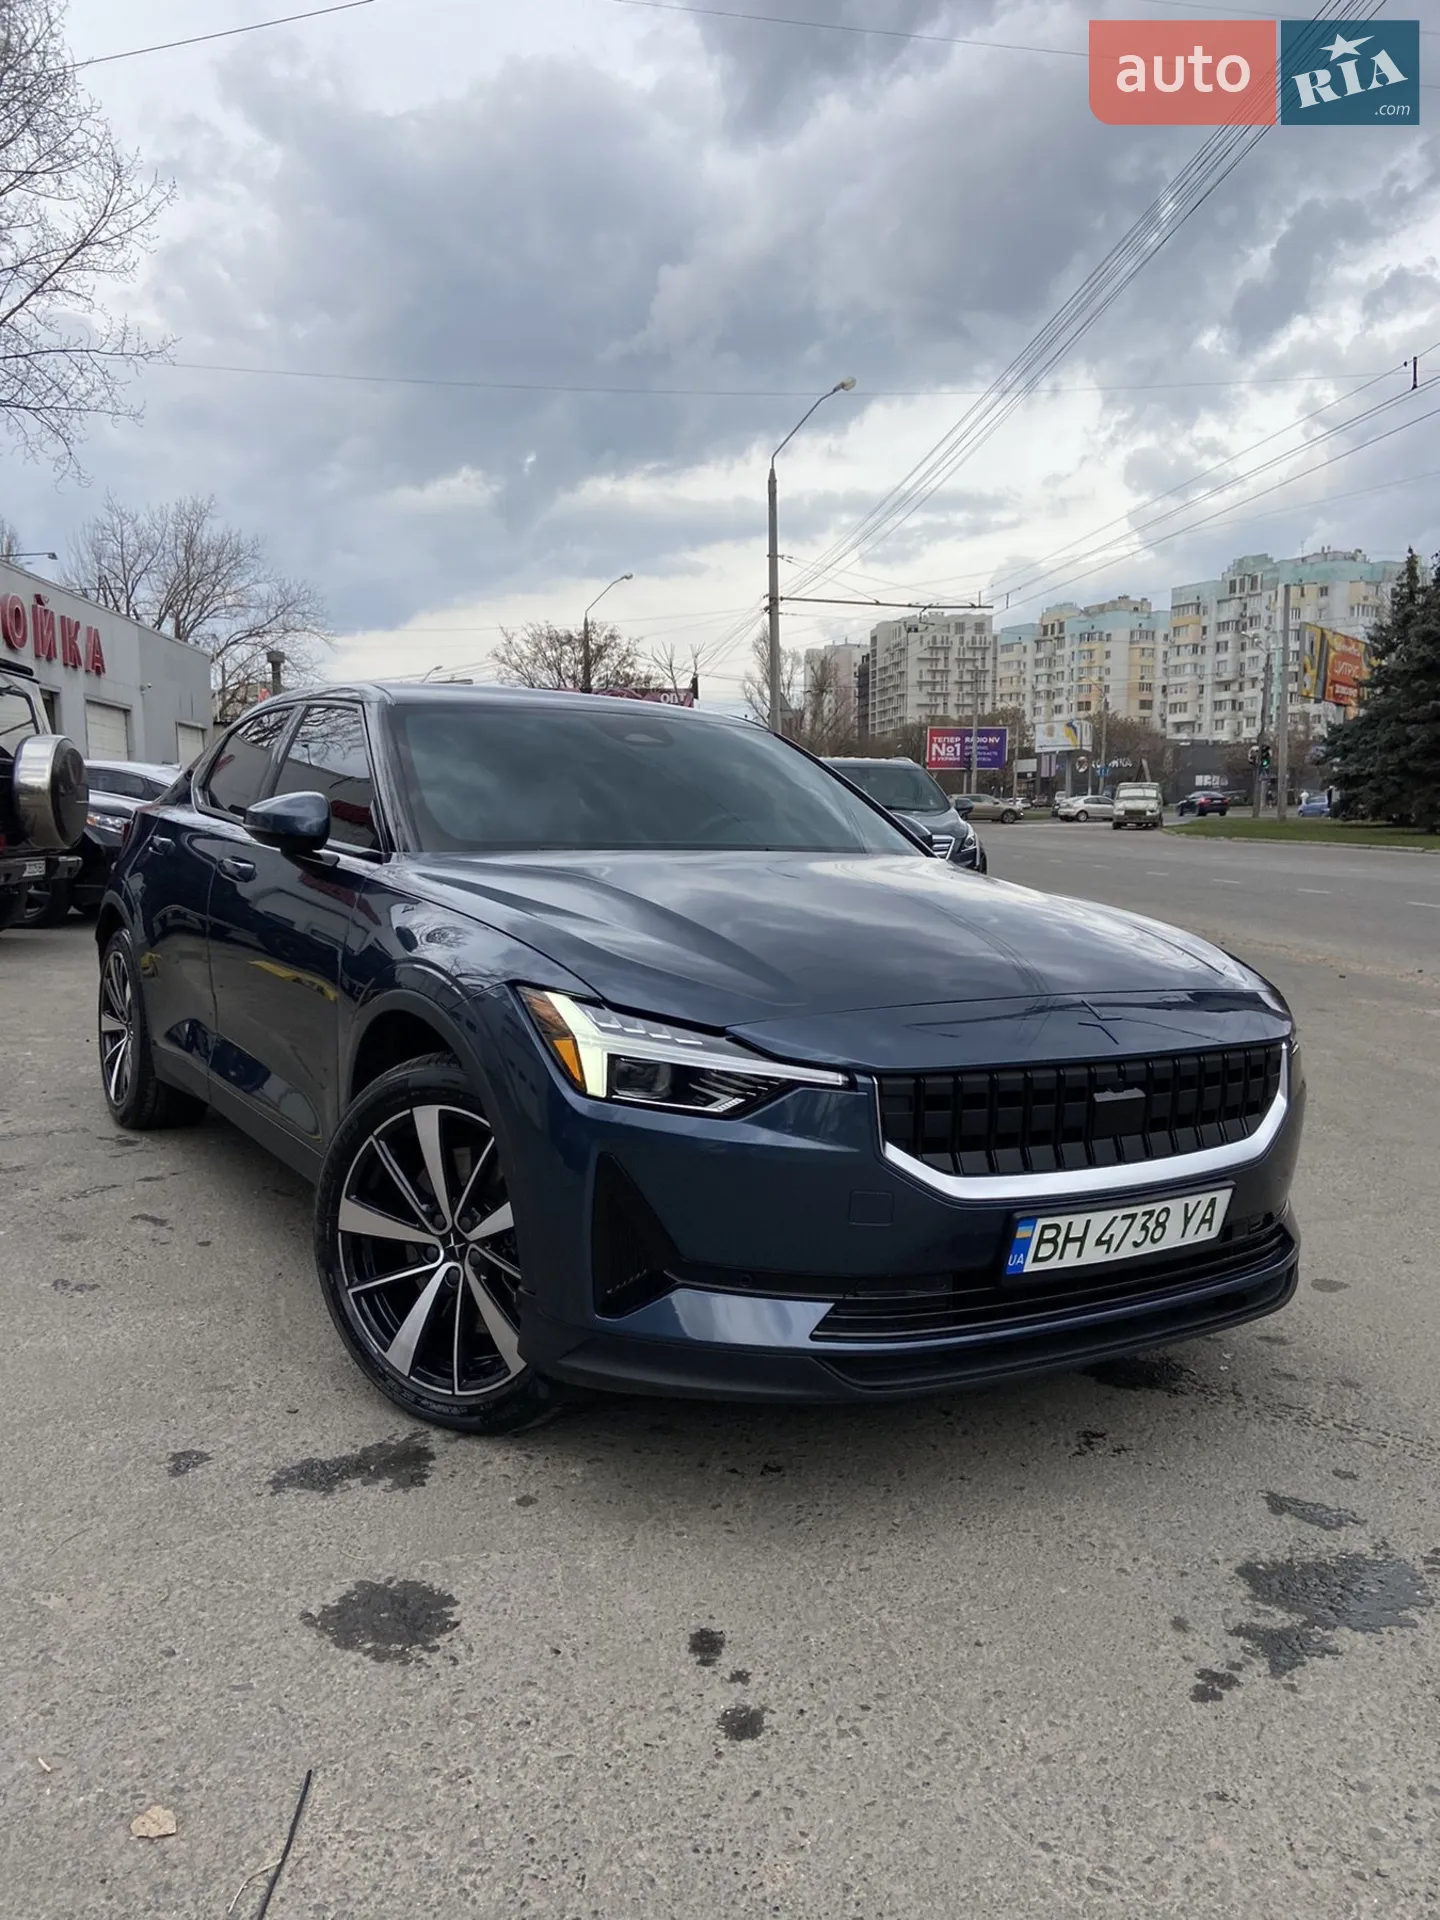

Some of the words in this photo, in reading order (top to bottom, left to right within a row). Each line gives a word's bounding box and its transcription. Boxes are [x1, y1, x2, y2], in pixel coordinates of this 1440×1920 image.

[1008, 1253, 1025, 1266] UA
[1031, 1219, 1091, 1264] BH
[1094, 1206, 1171, 1255] 4738
[1180, 1197, 1217, 1239] YA
